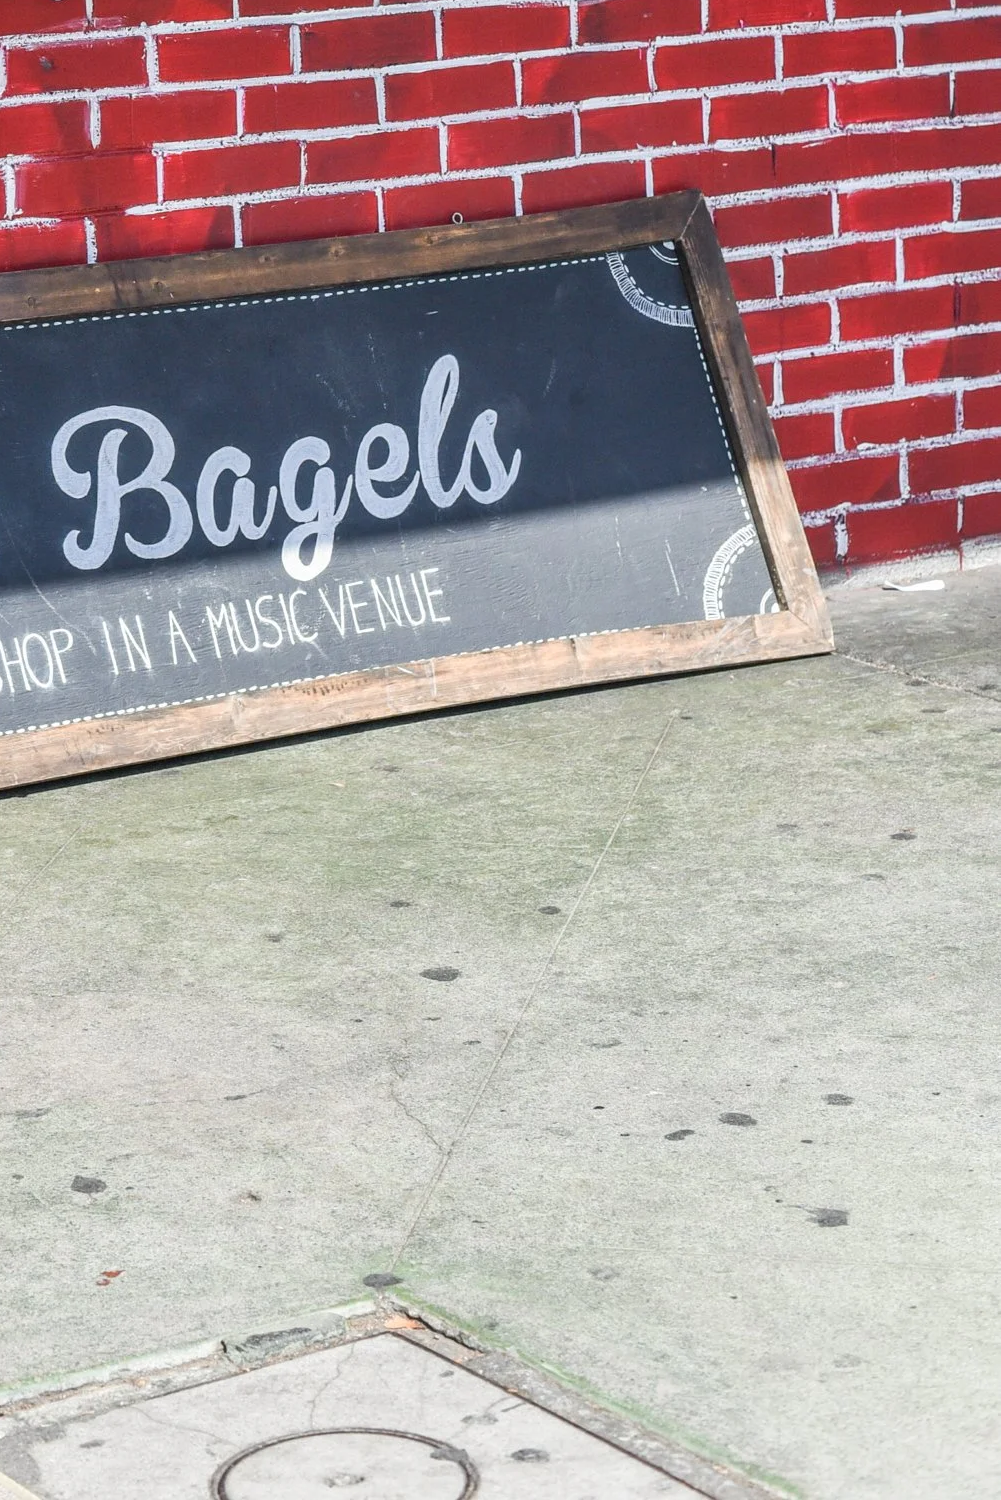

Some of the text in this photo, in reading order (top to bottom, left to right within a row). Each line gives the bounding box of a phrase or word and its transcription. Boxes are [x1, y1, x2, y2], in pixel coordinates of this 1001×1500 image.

[51, 354, 522, 581] Bagels
[102, 616, 158, 675] IN
[167, 611, 194, 666] A
[203, 587, 316, 654] MUSIC
[323, 567, 452, 638] VENUE
